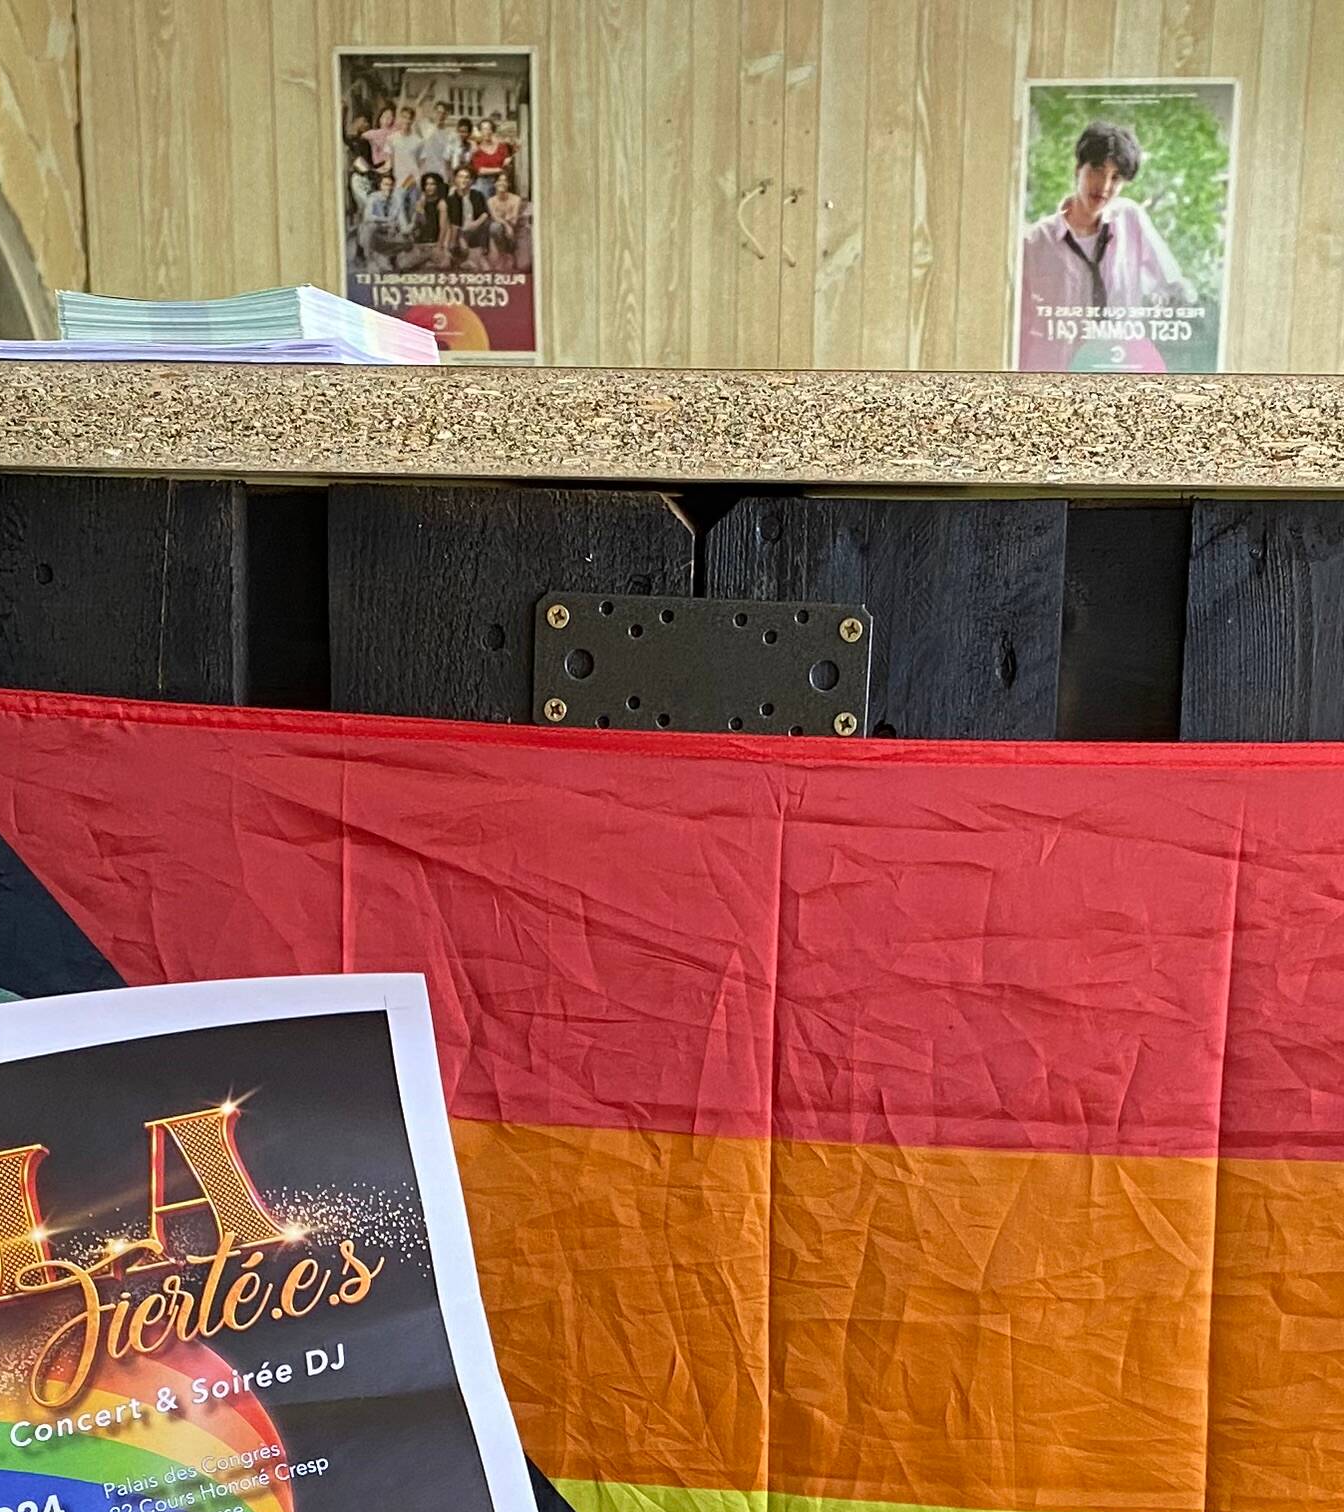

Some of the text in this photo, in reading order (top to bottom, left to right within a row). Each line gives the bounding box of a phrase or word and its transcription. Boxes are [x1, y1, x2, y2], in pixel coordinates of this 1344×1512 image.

[10, 1398, 142, 1448] Concert
[156, 1386, 177, 1414] &
[191, 1361, 293, 1405] Soirée
[306, 1343, 346, 1377] DJ
[103, 1441, 281, 1499] Palais des Congrès
[200, 1468, 270, 1500] Honoré
[274, 1456, 330, 1482] Cresp
